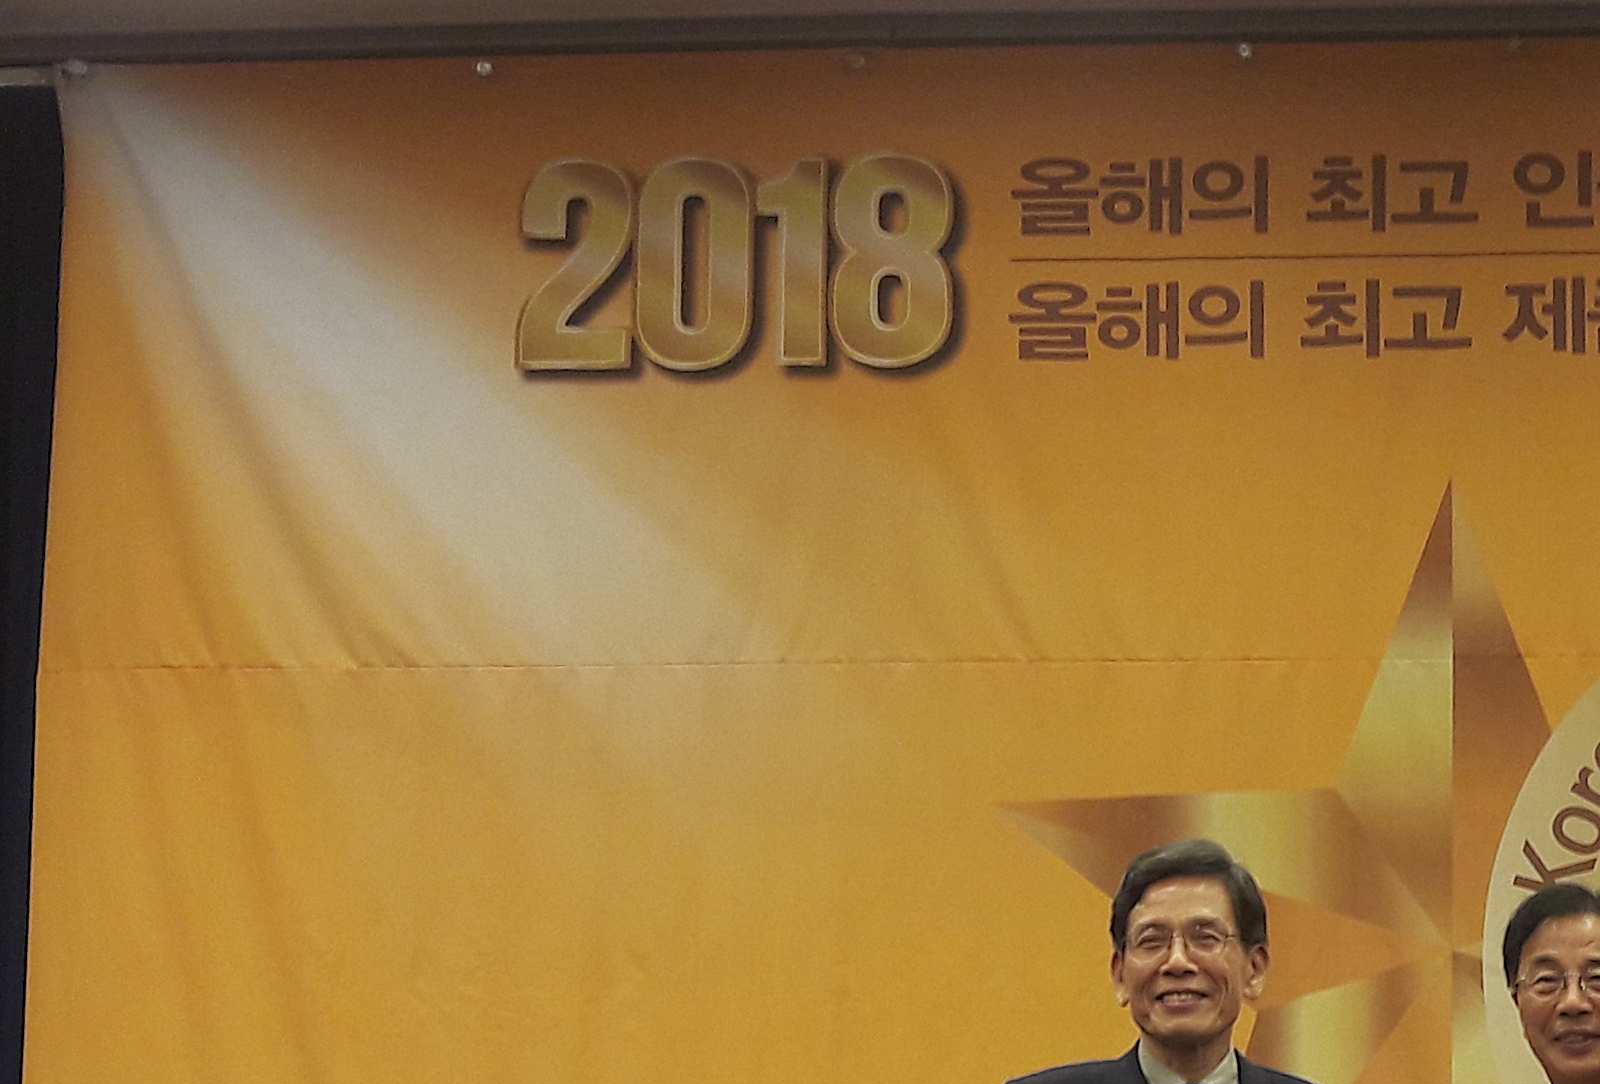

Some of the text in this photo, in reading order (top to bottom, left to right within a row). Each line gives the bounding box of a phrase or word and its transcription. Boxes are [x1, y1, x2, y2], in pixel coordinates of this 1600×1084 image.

[1010, 155, 1270, 237] 올해의
[1307, 154, 1475, 235] 최고
[514, 154, 958, 374] 2018
[1008, 278, 1266, 360] 올해의
[1301, 279, 1472, 356] 최고
